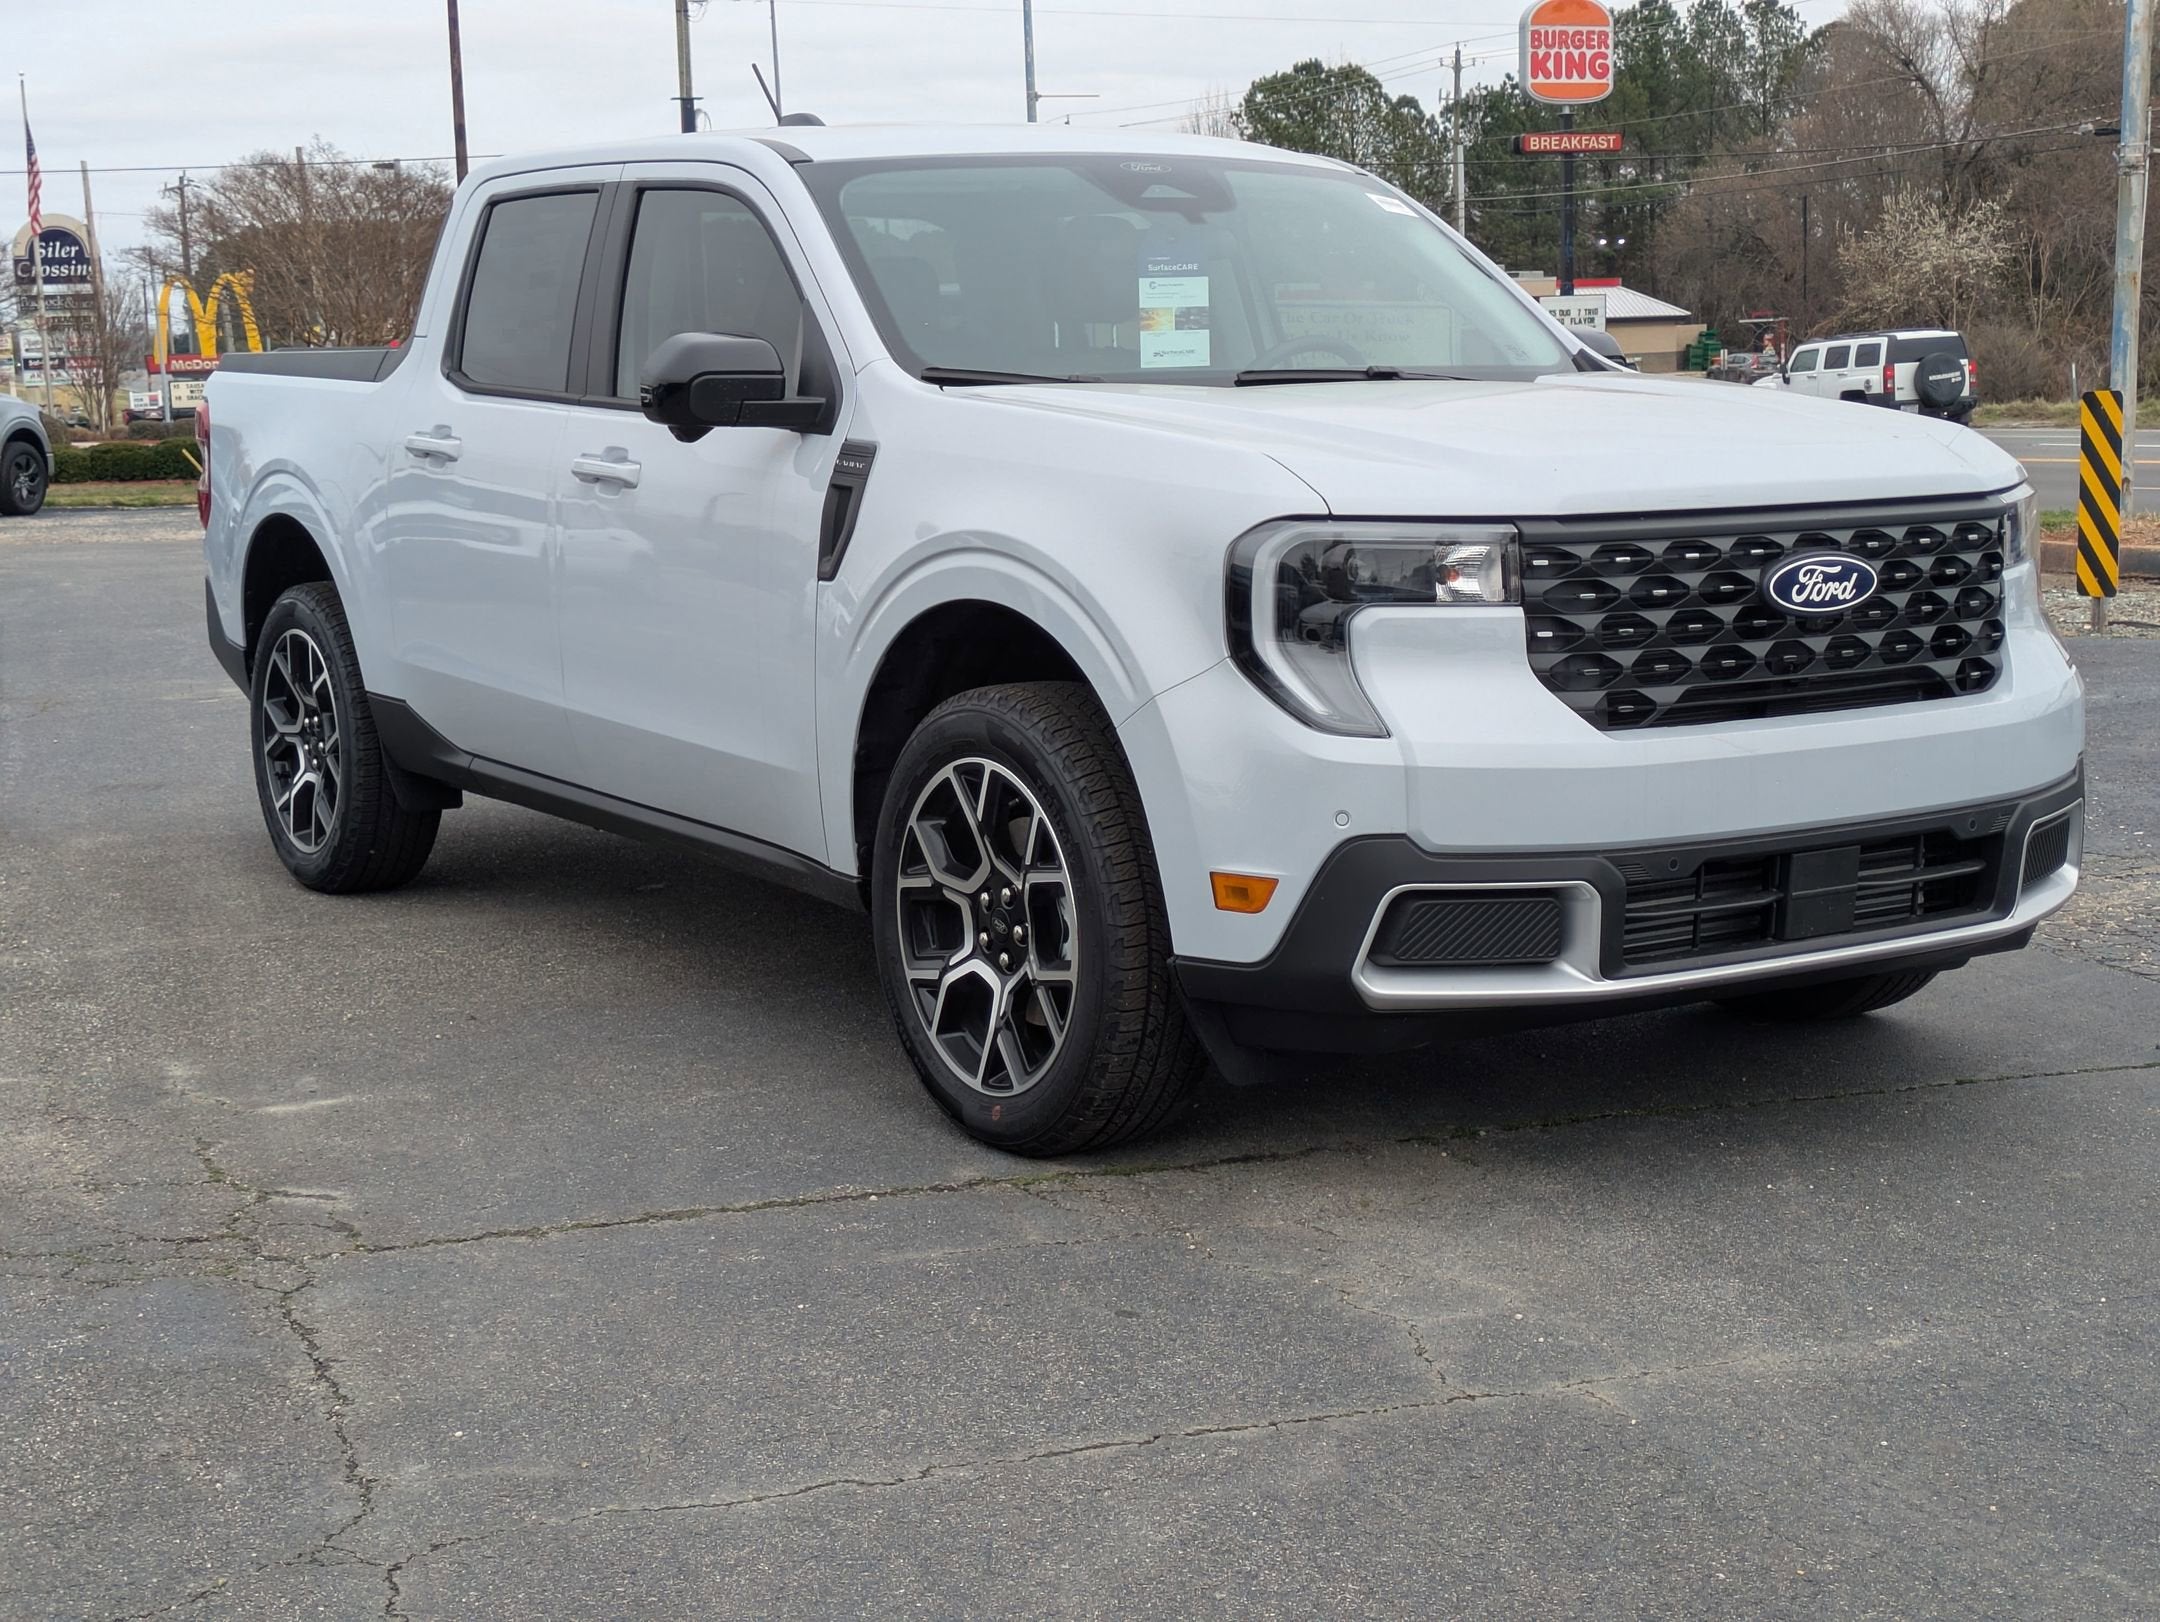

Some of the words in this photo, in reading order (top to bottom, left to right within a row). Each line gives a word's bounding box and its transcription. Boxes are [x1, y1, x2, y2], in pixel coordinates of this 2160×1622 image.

[1530, 29, 1610, 50] BURGER
[1530, 51, 1610, 80] KING
[1530, 135, 1616, 150] BREAKFAST
[38, 241, 79, 258] Siler
[1147, 263, 1199, 272] SurfaceCARE
[1791, 564, 1858, 603] Ford
